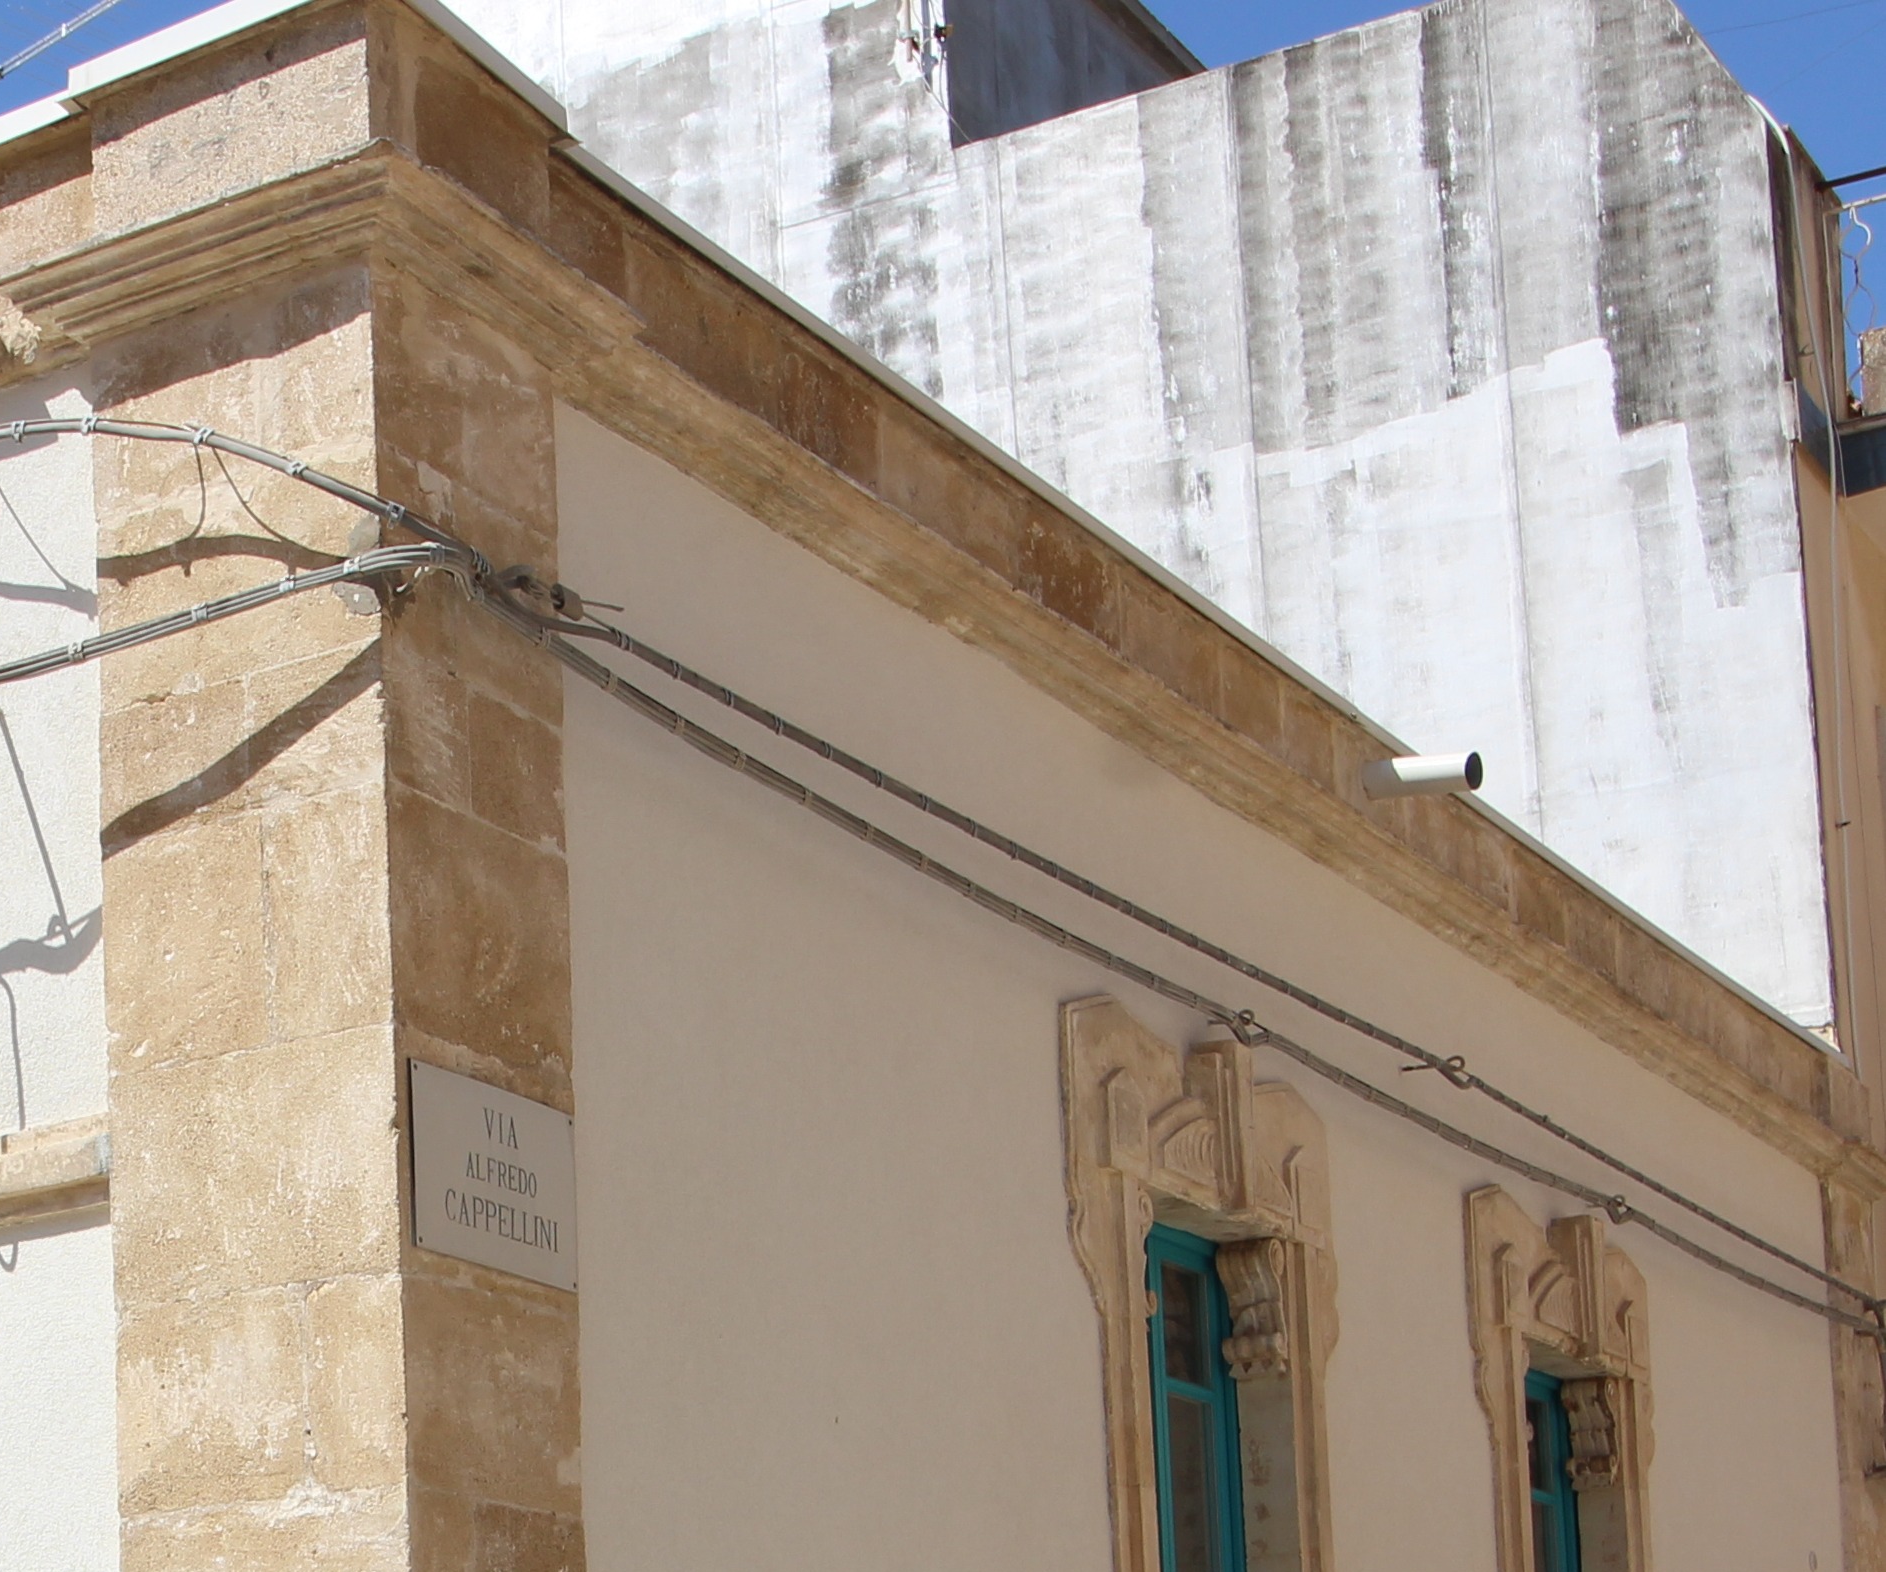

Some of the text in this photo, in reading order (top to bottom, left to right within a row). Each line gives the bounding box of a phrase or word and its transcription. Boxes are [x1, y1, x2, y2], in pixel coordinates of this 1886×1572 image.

[483, 1107, 519, 1150] VIA
[466, 1151, 538, 1199] ALFREDO
[445, 1188, 559, 1253] CAPPELLINI
